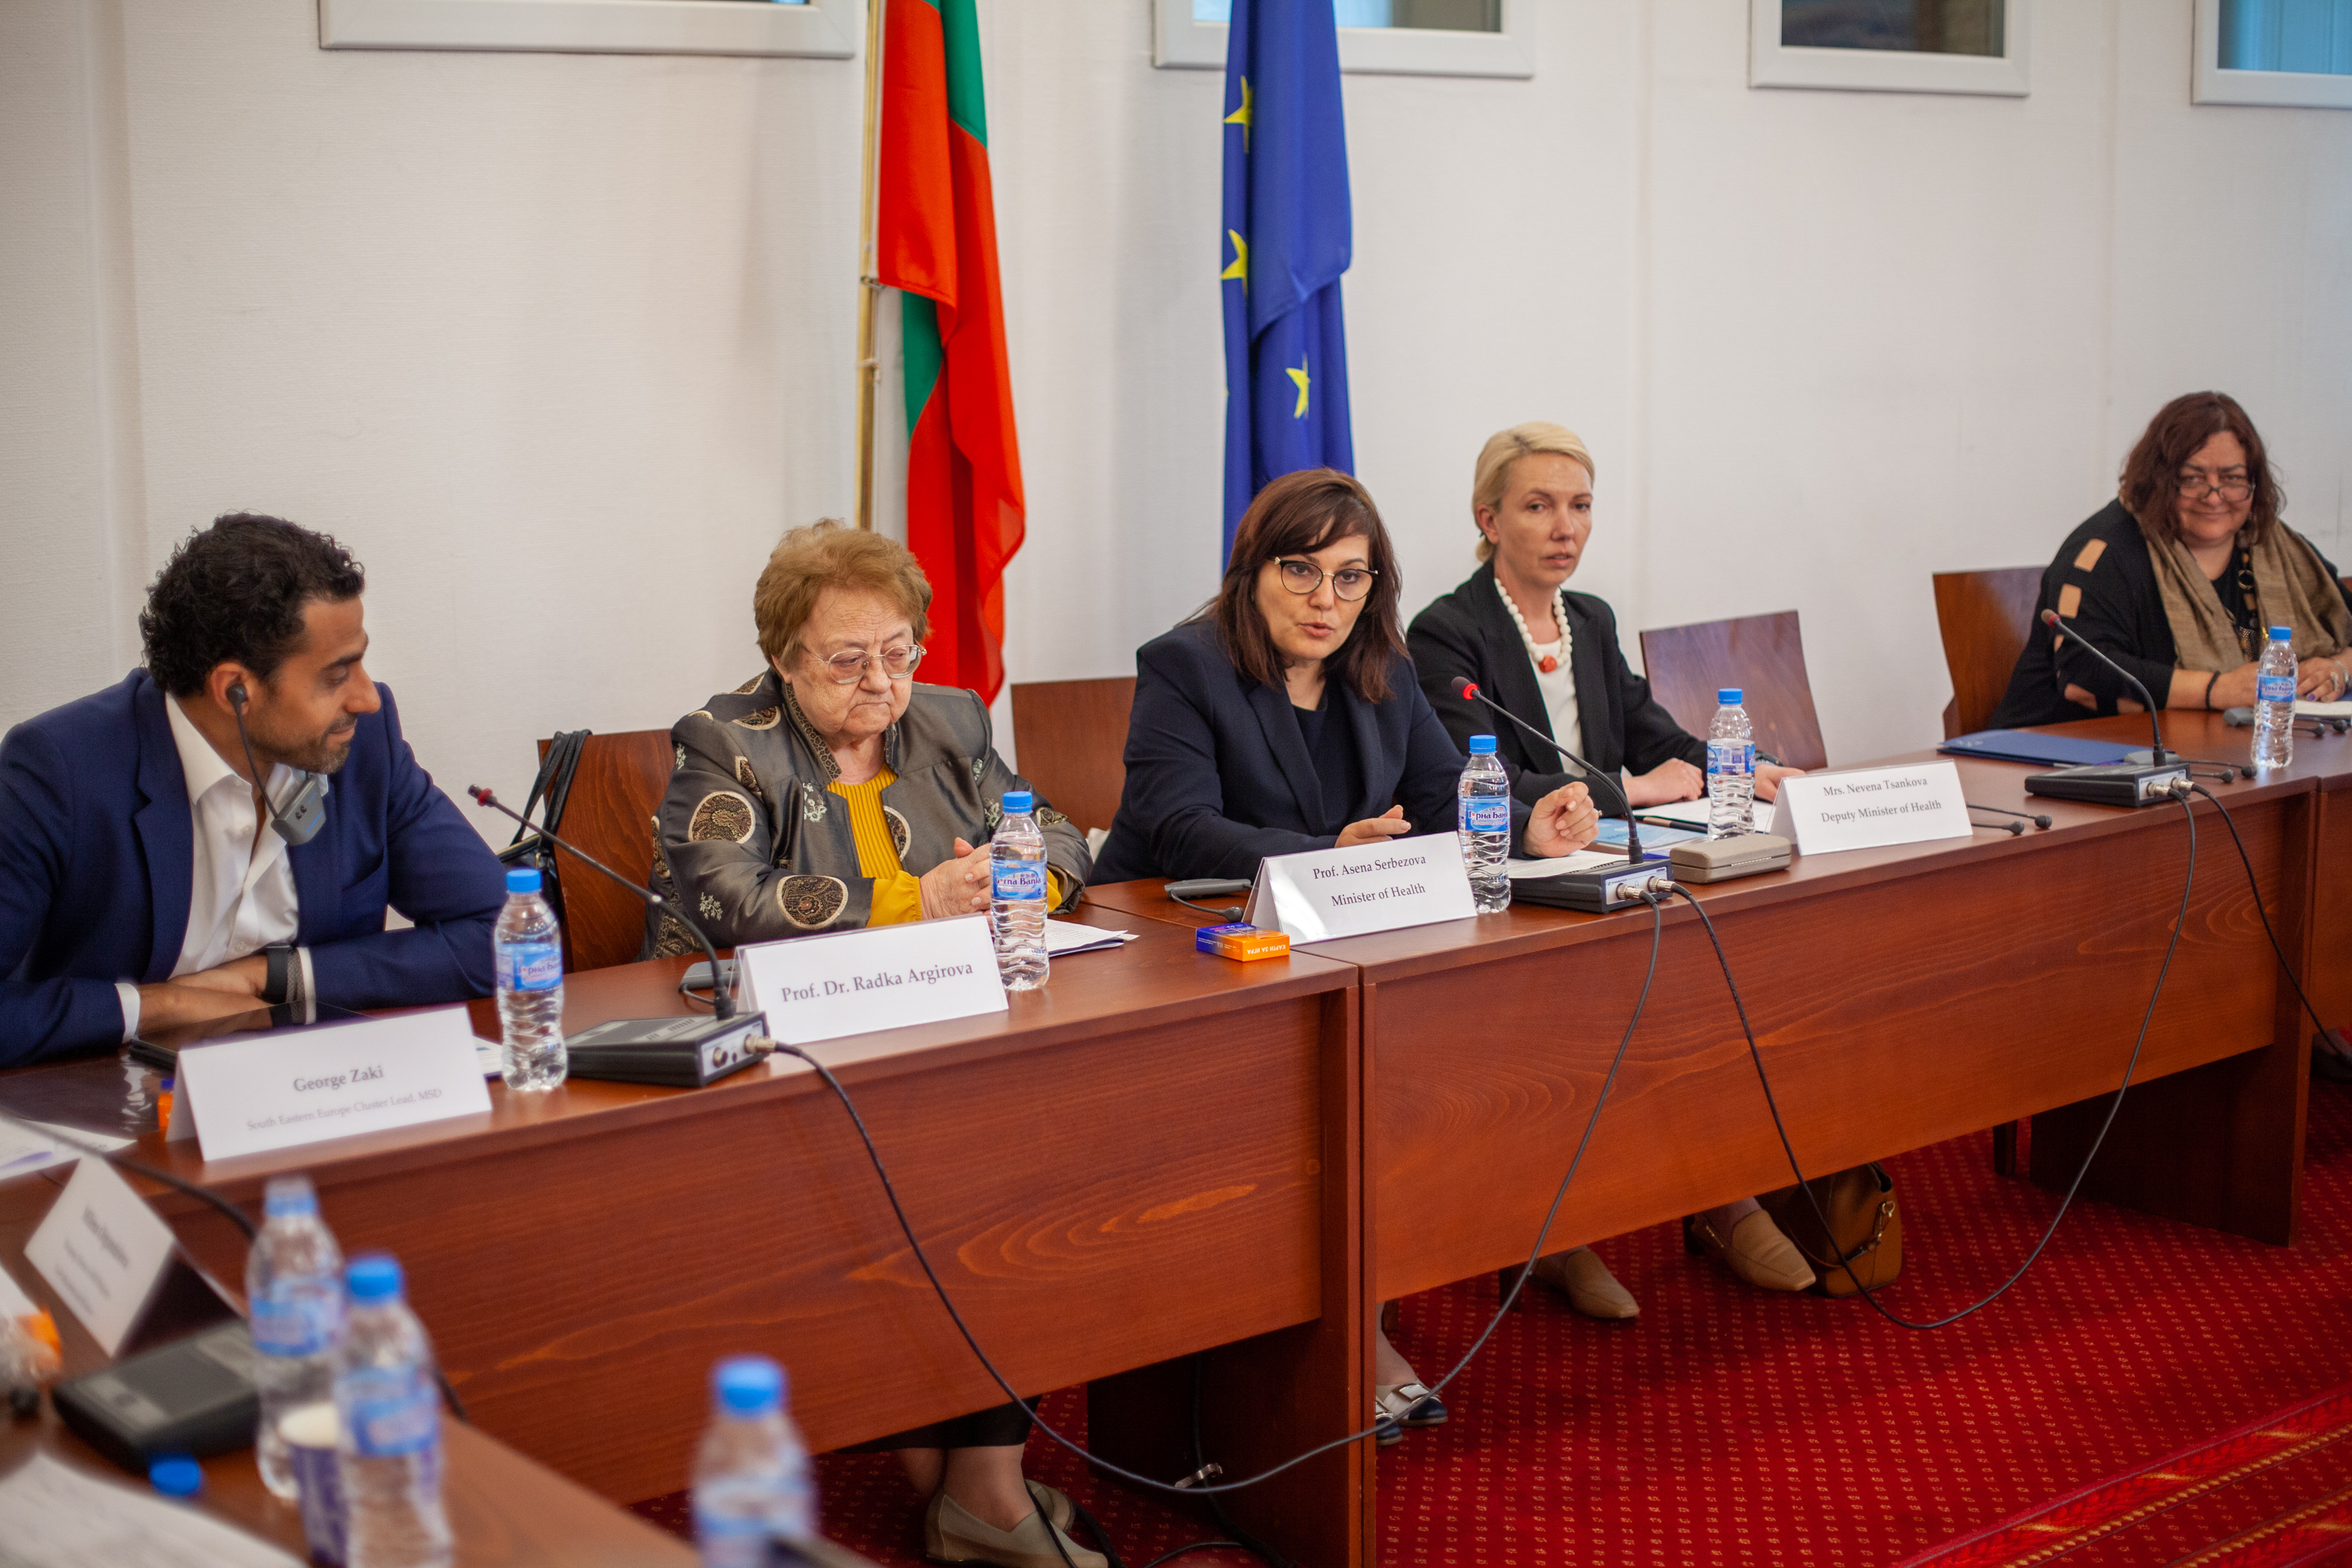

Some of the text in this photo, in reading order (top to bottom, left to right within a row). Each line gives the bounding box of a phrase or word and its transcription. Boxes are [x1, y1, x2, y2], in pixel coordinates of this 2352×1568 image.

[1823, 778, 1928, 797] Mrs. Nevena Tsankova
[1820, 800, 1942, 824] Deputy Minister of Health
[1312, 856, 1427, 880] Prof. Asena Serbezova
[1330, 883, 1426, 907] Minister of Health
[1269, 943, 1287, 952] КАРТИ
[781, 964, 974, 1003] Prof. Dr. Radka Argirova
[292, 1065, 384, 1092] George Zaki
[246, 1087, 442, 1131] South Eastern Europe Cluster Lead, MSD
